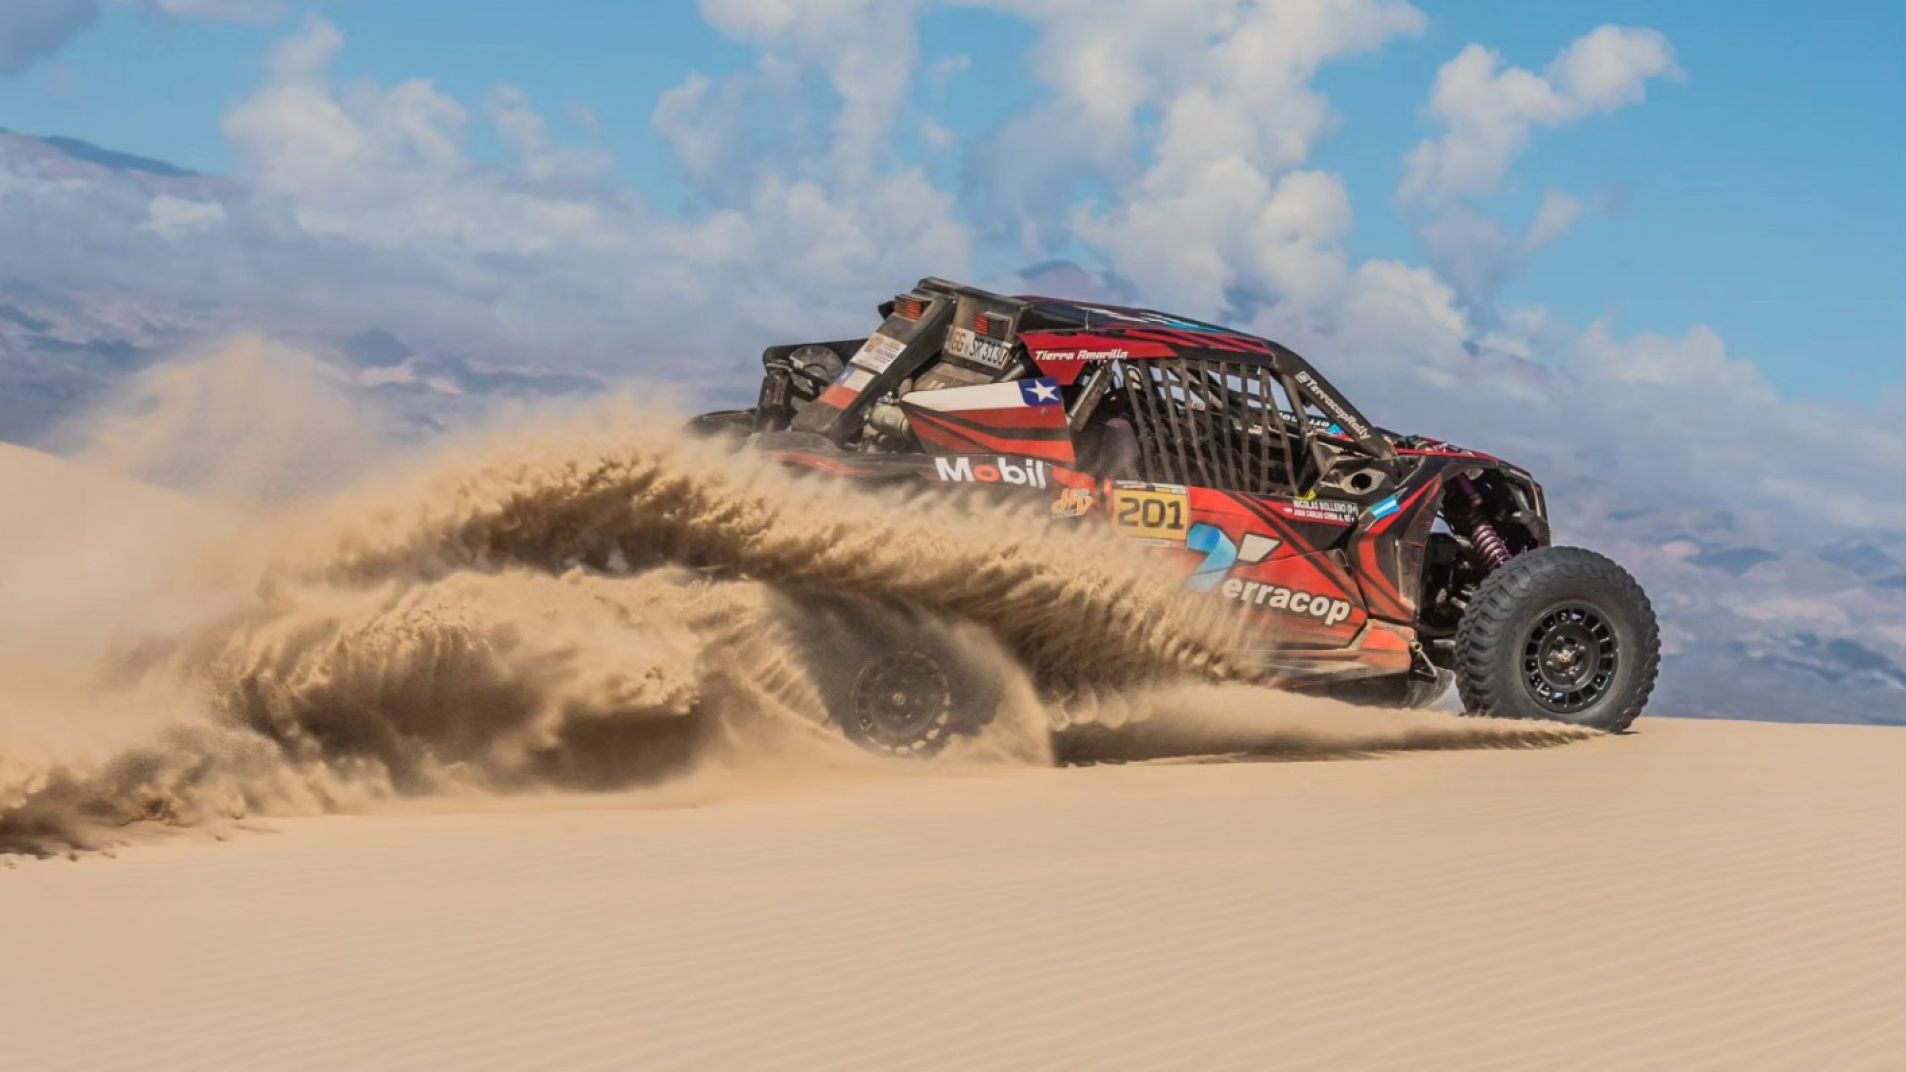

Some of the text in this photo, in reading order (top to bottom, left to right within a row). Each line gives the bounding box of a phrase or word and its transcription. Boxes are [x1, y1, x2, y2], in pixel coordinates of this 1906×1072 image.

[1035, 348, 1128, 360] Tierra Amarilla
[935, 457, 1047, 489] Mobil
[1119, 497, 1184, 530] 201
